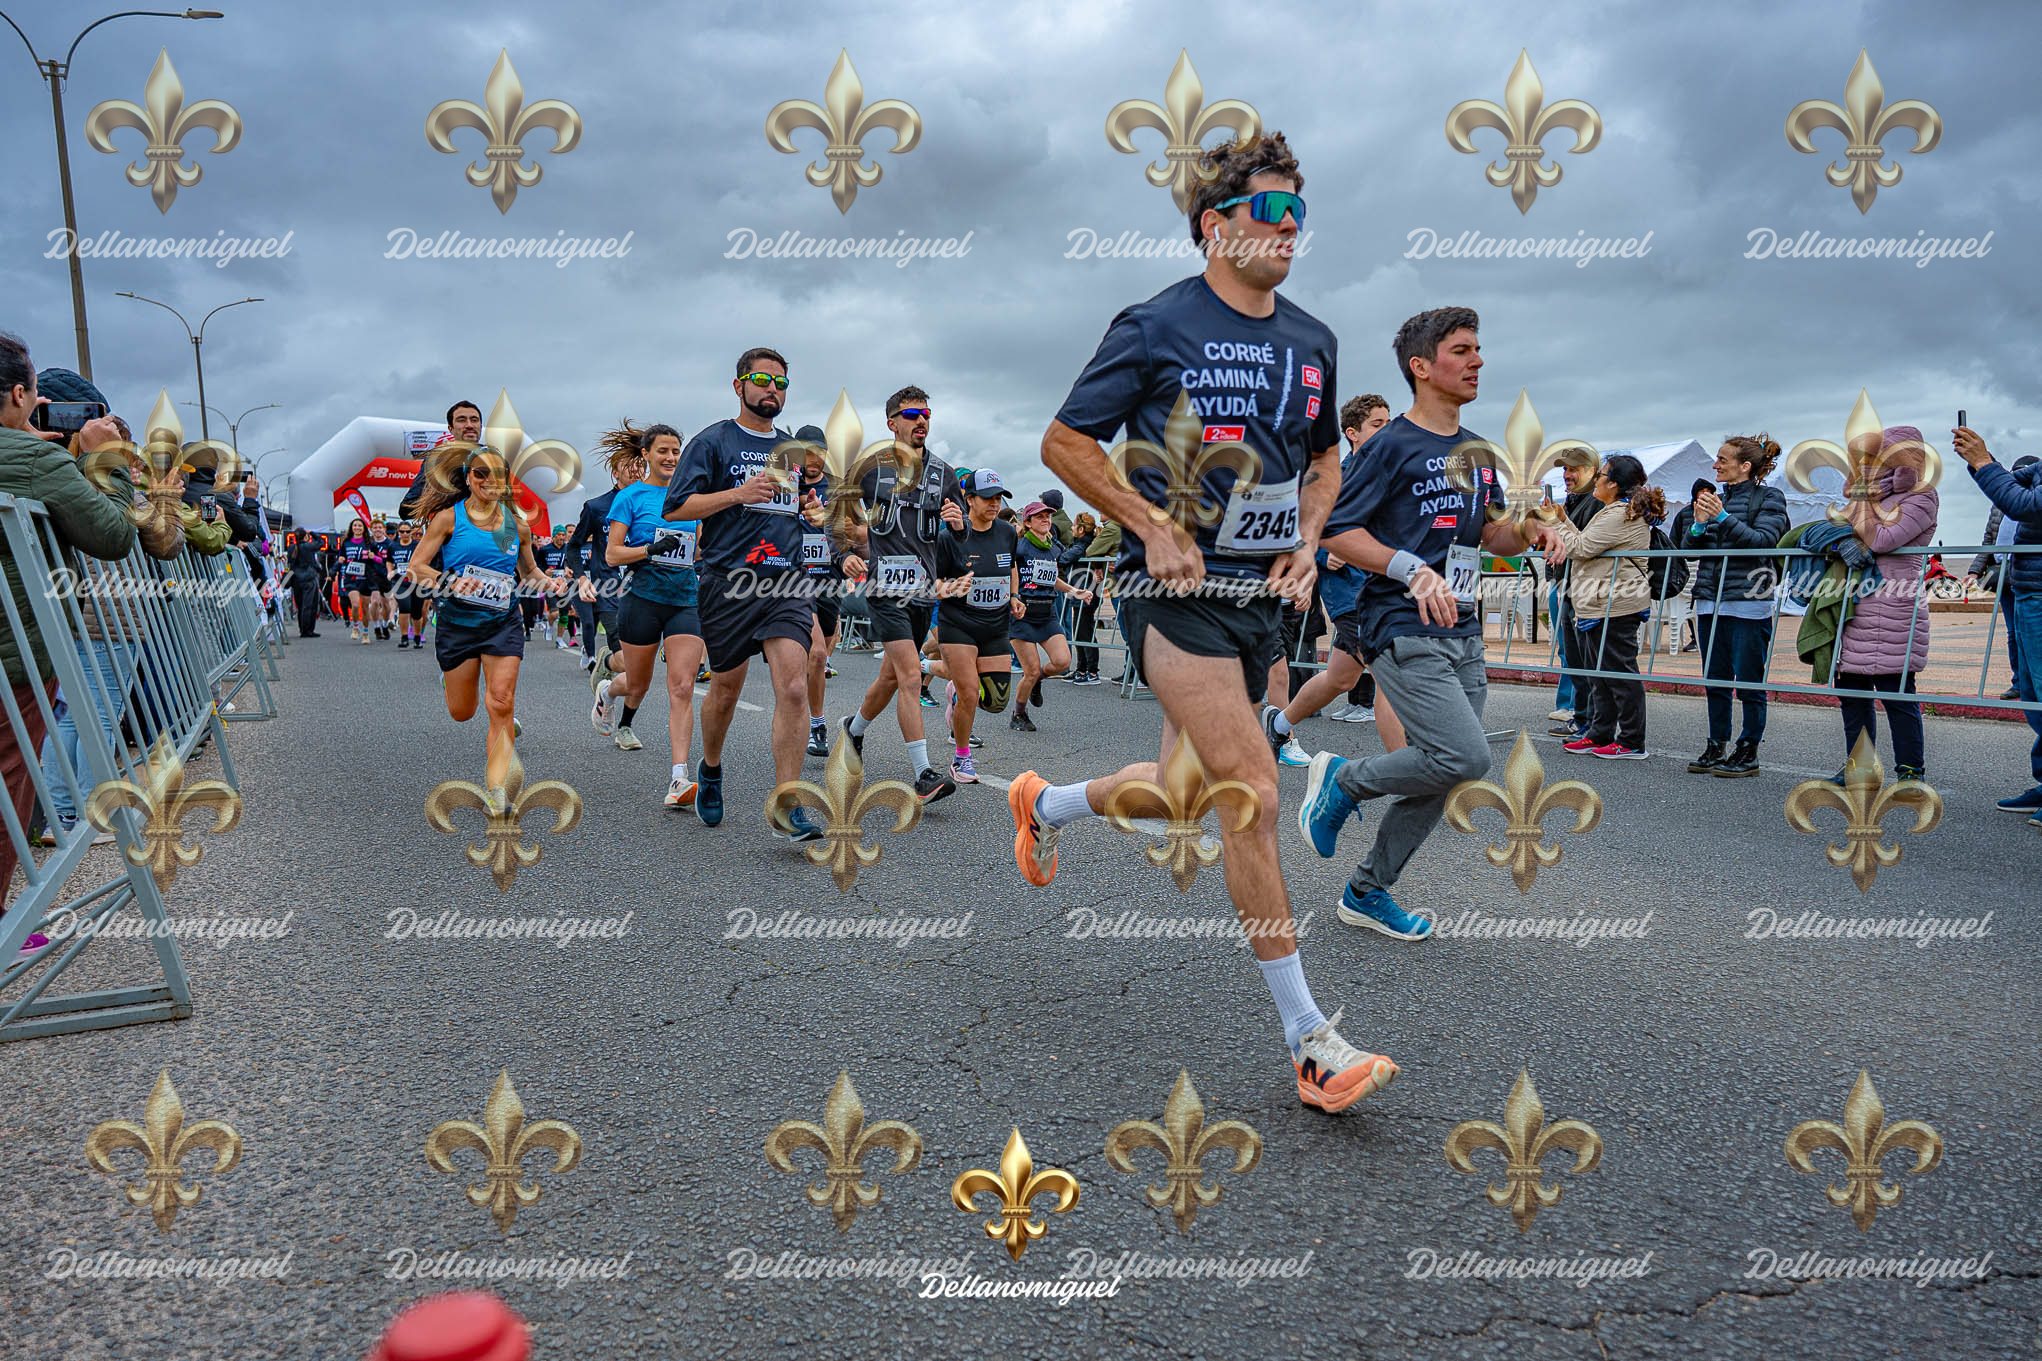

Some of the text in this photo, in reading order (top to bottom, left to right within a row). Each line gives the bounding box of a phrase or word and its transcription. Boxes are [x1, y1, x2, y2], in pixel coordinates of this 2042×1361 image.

[1204, 341, 1275, 365] CORRÉ
[1180, 366, 1270, 390] CAMINÁ
[1305, 370, 1319, 385] 5K
[1186, 393, 1259, 417] AYUDÁ
[740, 451, 779, 462] CORRÉ
[1425, 453, 1468, 472] CORRÉ
[1411, 472, 1467, 497] CAMINÁ
[1419, 491, 1465, 517] AYUDÁ
[1233, 506, 1297, 540] 2345
[884, 568, 916, 586] 2478
[973, 588, 1001, 603] 3184
